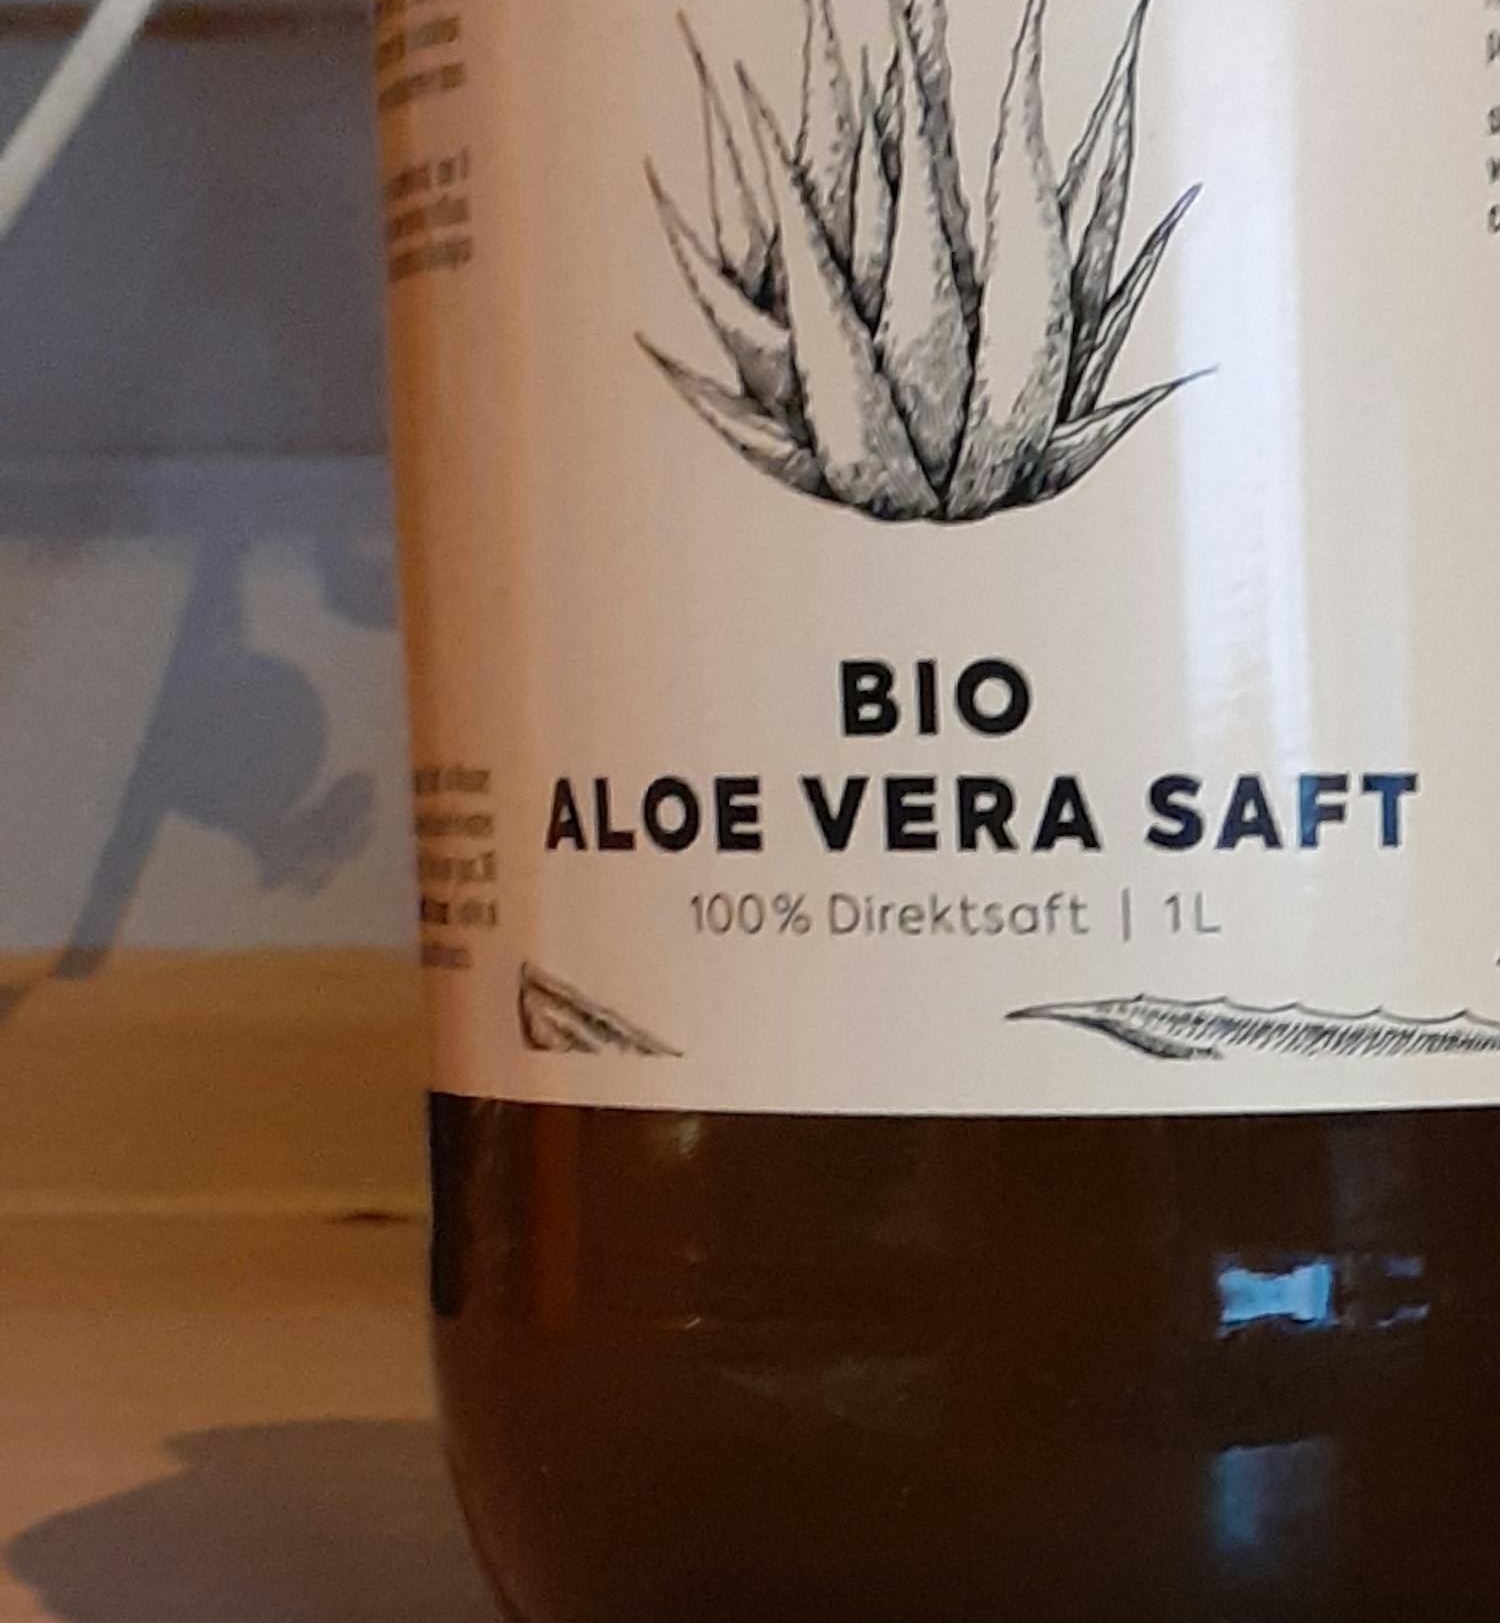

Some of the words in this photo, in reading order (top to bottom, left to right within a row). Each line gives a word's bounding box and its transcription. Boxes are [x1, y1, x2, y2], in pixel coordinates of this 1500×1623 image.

[838, 658, 1033, 737] BIO
[545, 775, 764, 852] ALOE
[801, 774, 1104, 852] VERA
[1143, 773, 1419, 852] SAFT
[691, 891, 812, 936] 100%
[828, 891, 1091, 936] Direktsaft
